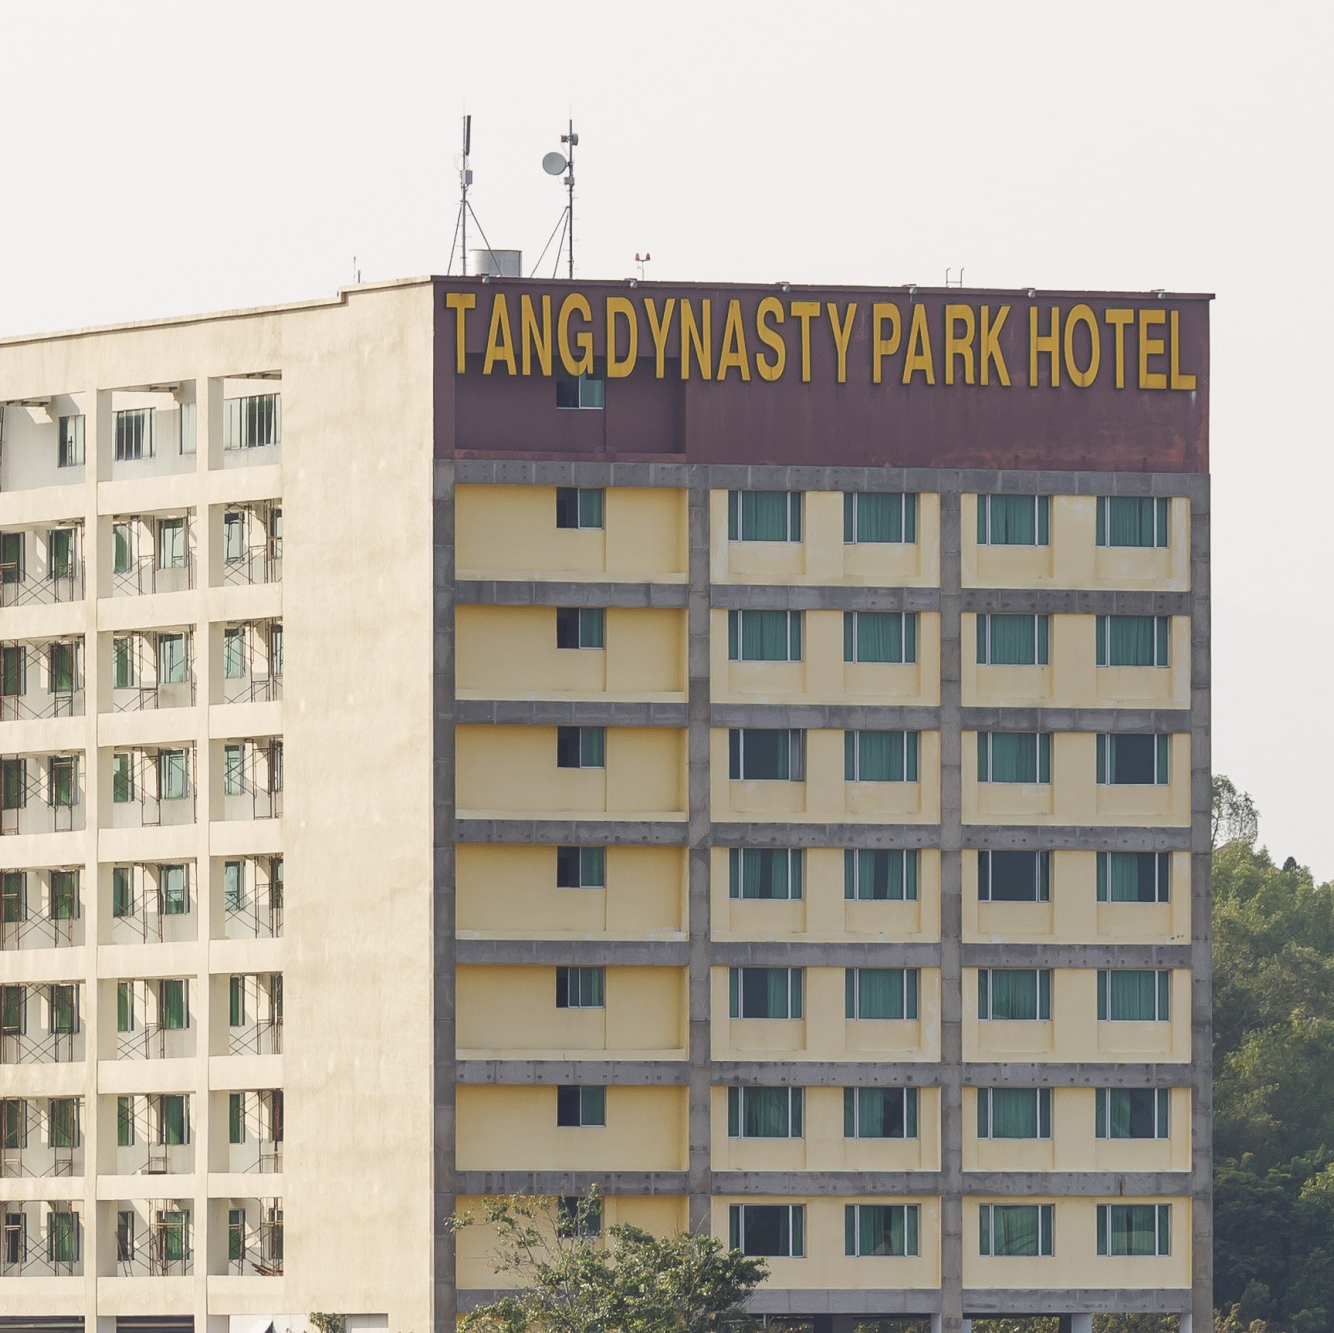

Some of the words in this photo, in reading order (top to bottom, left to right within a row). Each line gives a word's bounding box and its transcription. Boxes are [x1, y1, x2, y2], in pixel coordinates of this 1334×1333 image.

[446, 293, 594, 377] TANG
[606, 296, 858, 383] DYNASTY
[872, 302, 1012, 387] PARK
[1030, 303, 1197, 391] HOTEL
